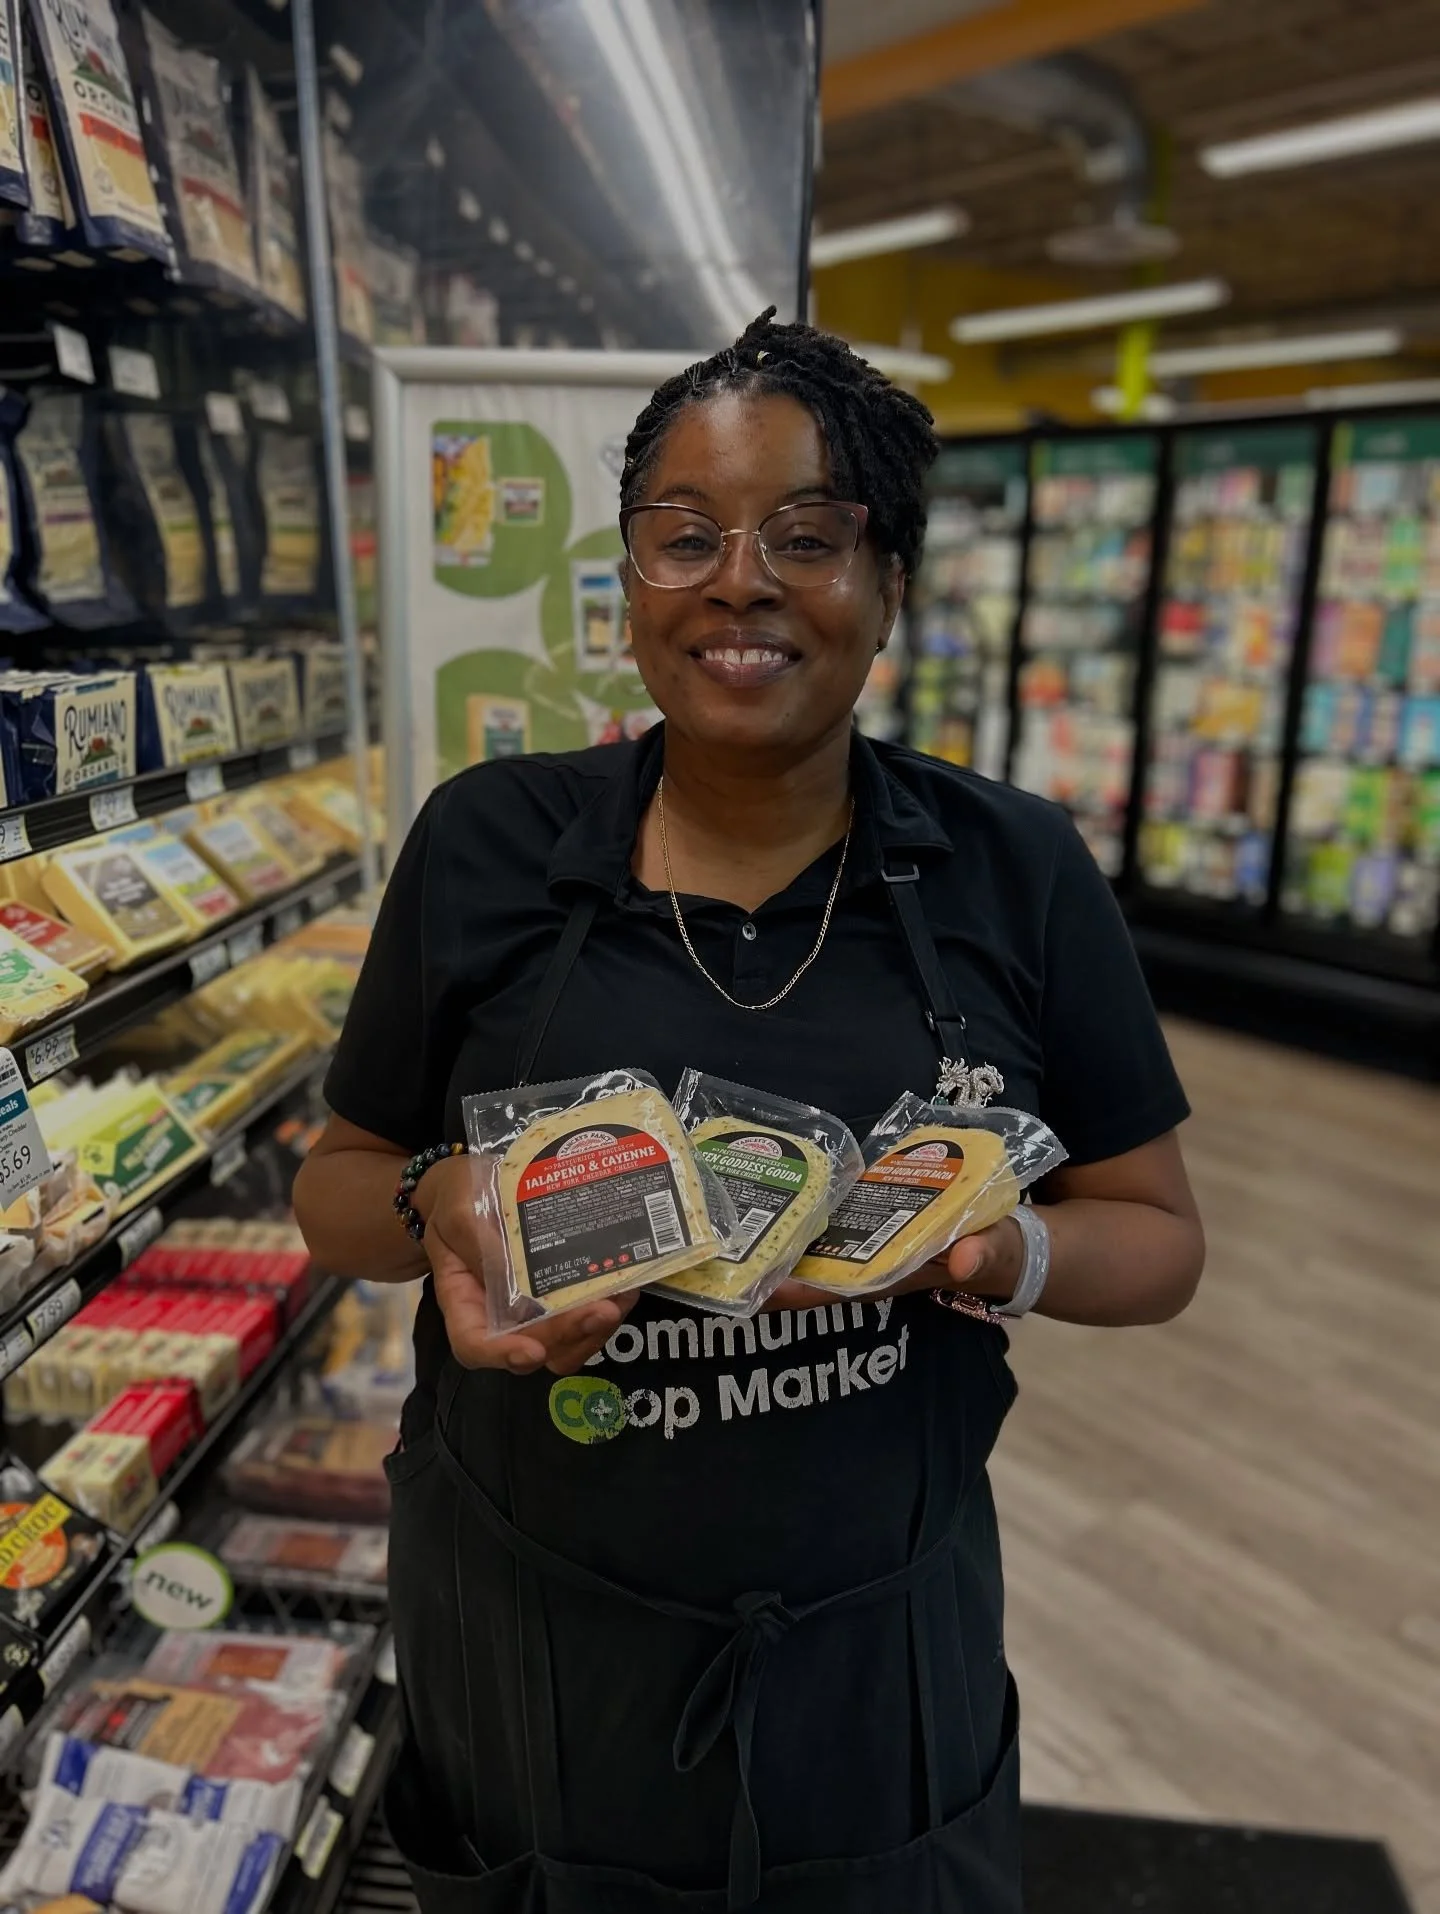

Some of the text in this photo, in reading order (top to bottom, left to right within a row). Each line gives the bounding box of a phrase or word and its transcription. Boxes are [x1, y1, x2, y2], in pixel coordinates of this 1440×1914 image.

[64, 700, 127, 757] RUMIANO
[30, 1038, 59, 1065] $6.99
[0, 1098, 19, 1117] eals
[588, 1159, 600, 1172] &
[601, 1145, 657, 1168] CAYENNE
[701, 1151, 803, 1183] EEN GODDESS GOUDA
[711, 1164, 763, 1181] NEW YORK CHEESE
[546, 1160, 639, 1191] NEW YORK CHEDDAR CHEESE
[583, 1296, 894, 1366] ommunity
[717, 1323, 910, 1422] Market
[145, 1571, 215, 1611] new
